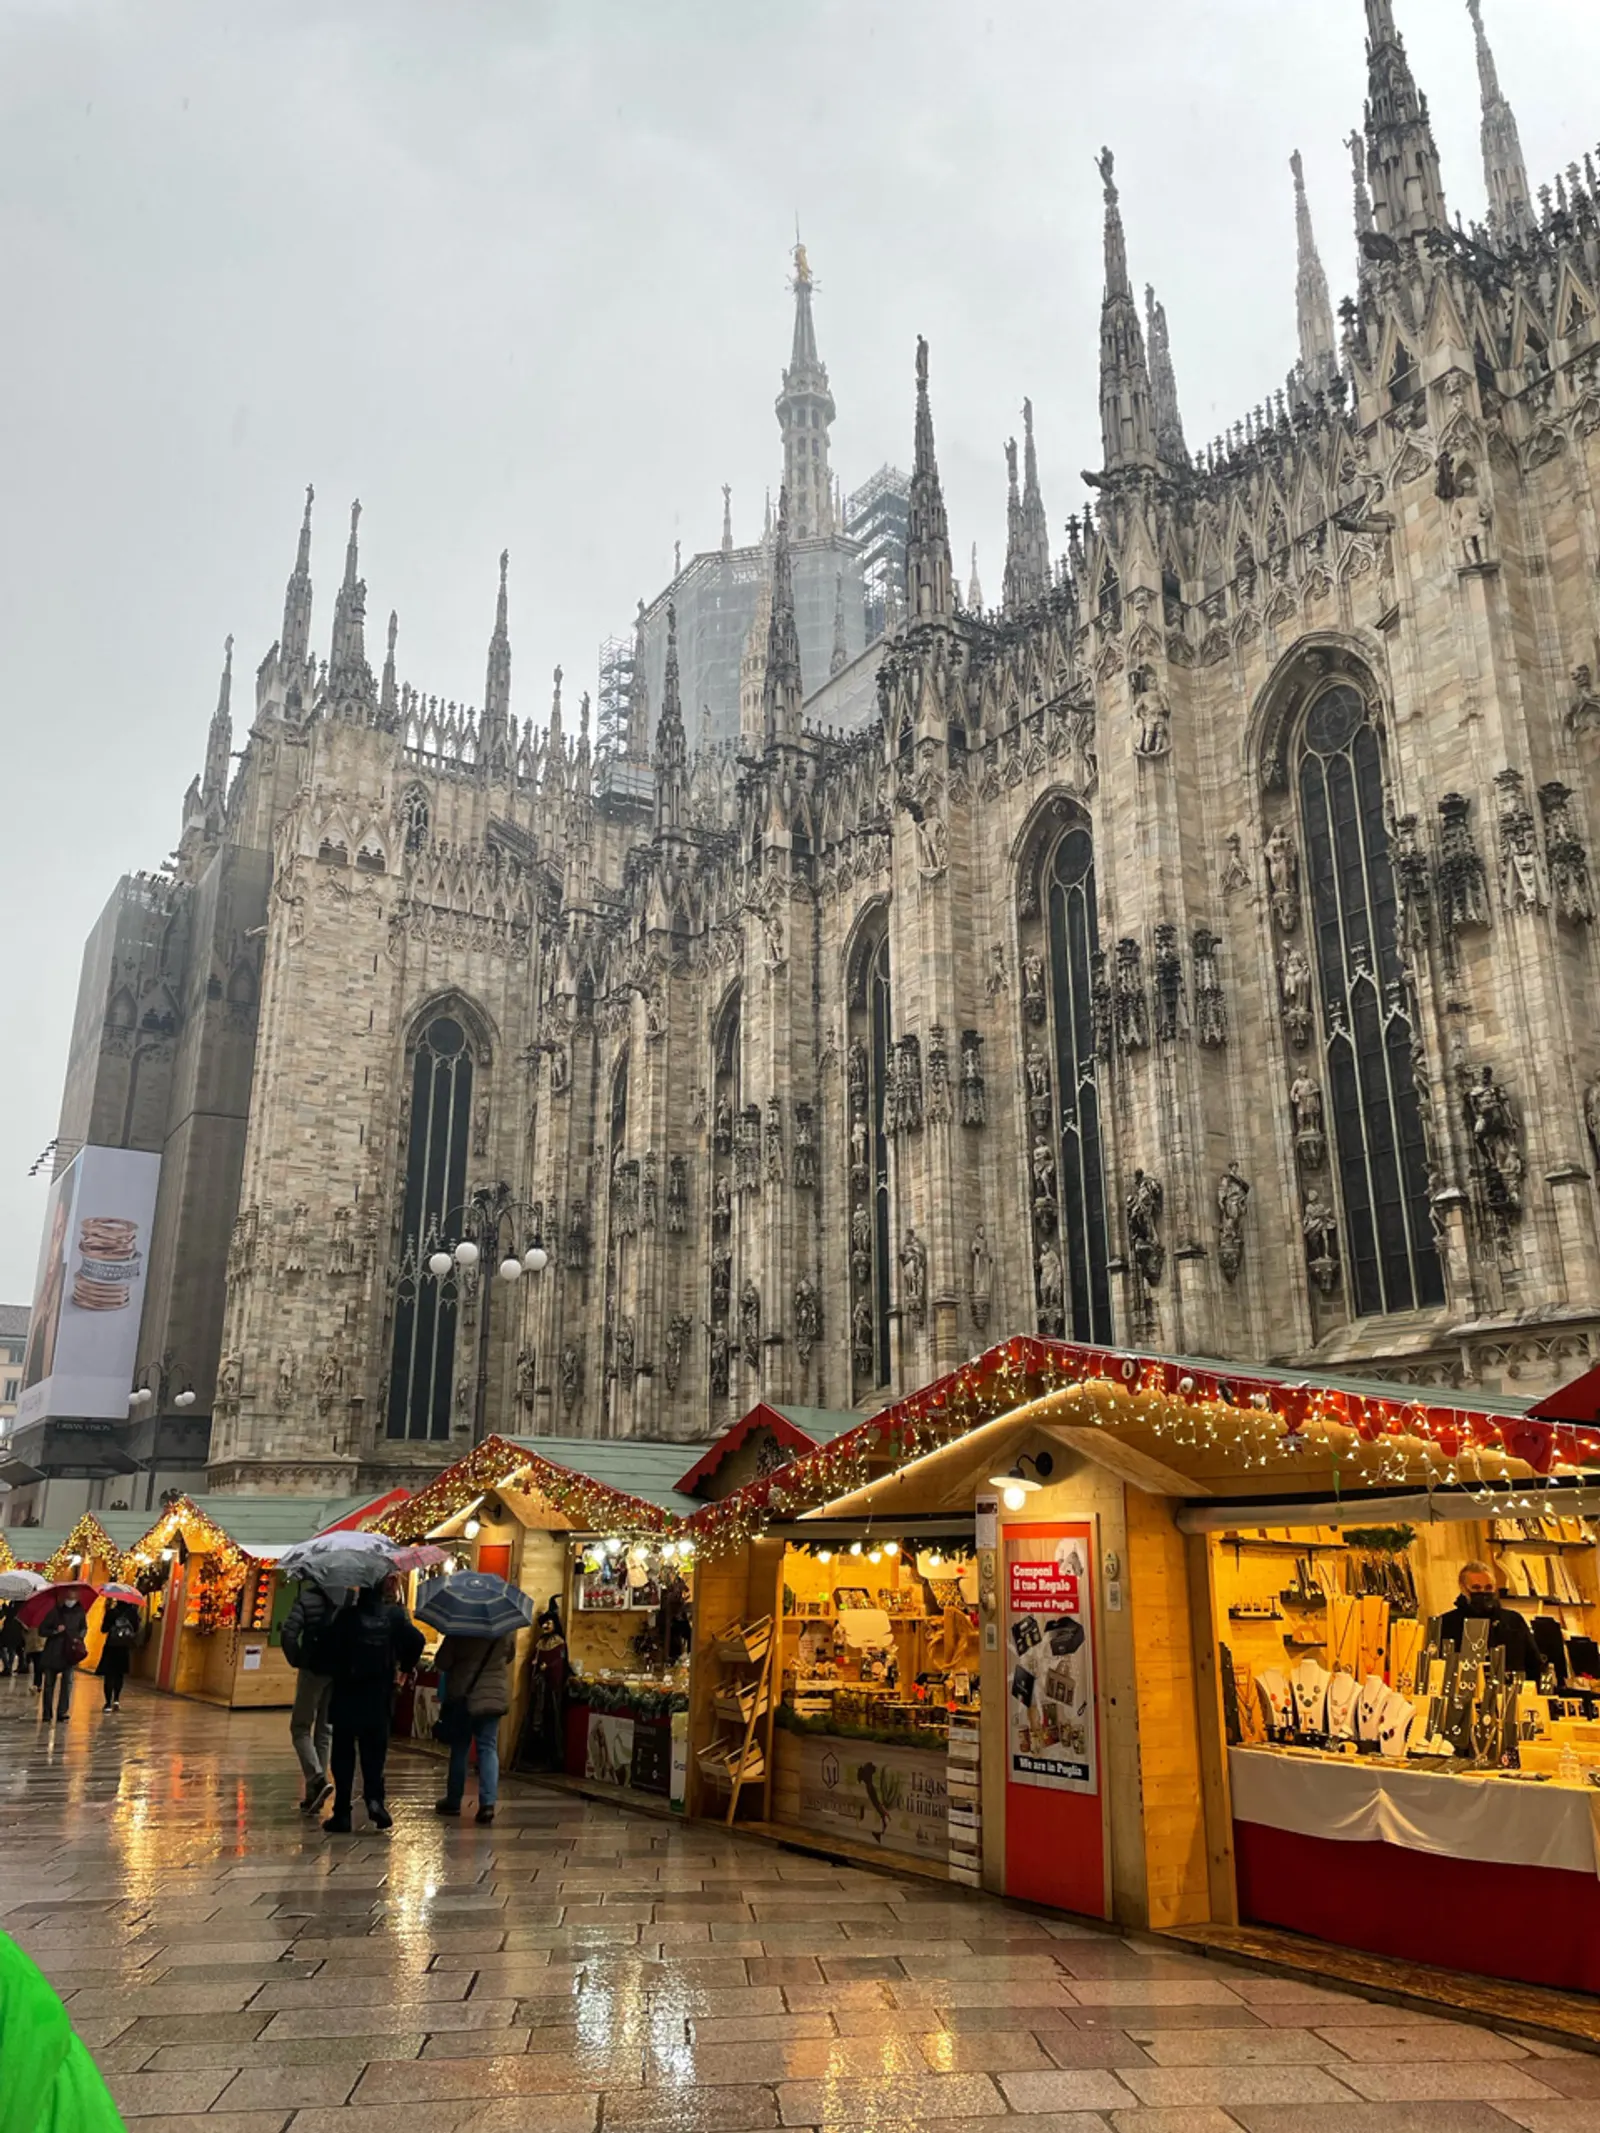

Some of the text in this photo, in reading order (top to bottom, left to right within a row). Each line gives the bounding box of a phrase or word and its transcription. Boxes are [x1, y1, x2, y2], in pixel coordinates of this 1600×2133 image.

[1013, 1564, 1053, 1579] Componi
[1013, 1578, 1071, 1594] il tuo Regalo
[1043, 1599, 1051, 1608] di
[1051, 1599, 1075, 1611] Puglia
[1019, 1757, 1082, 1778] We are in Puglia
